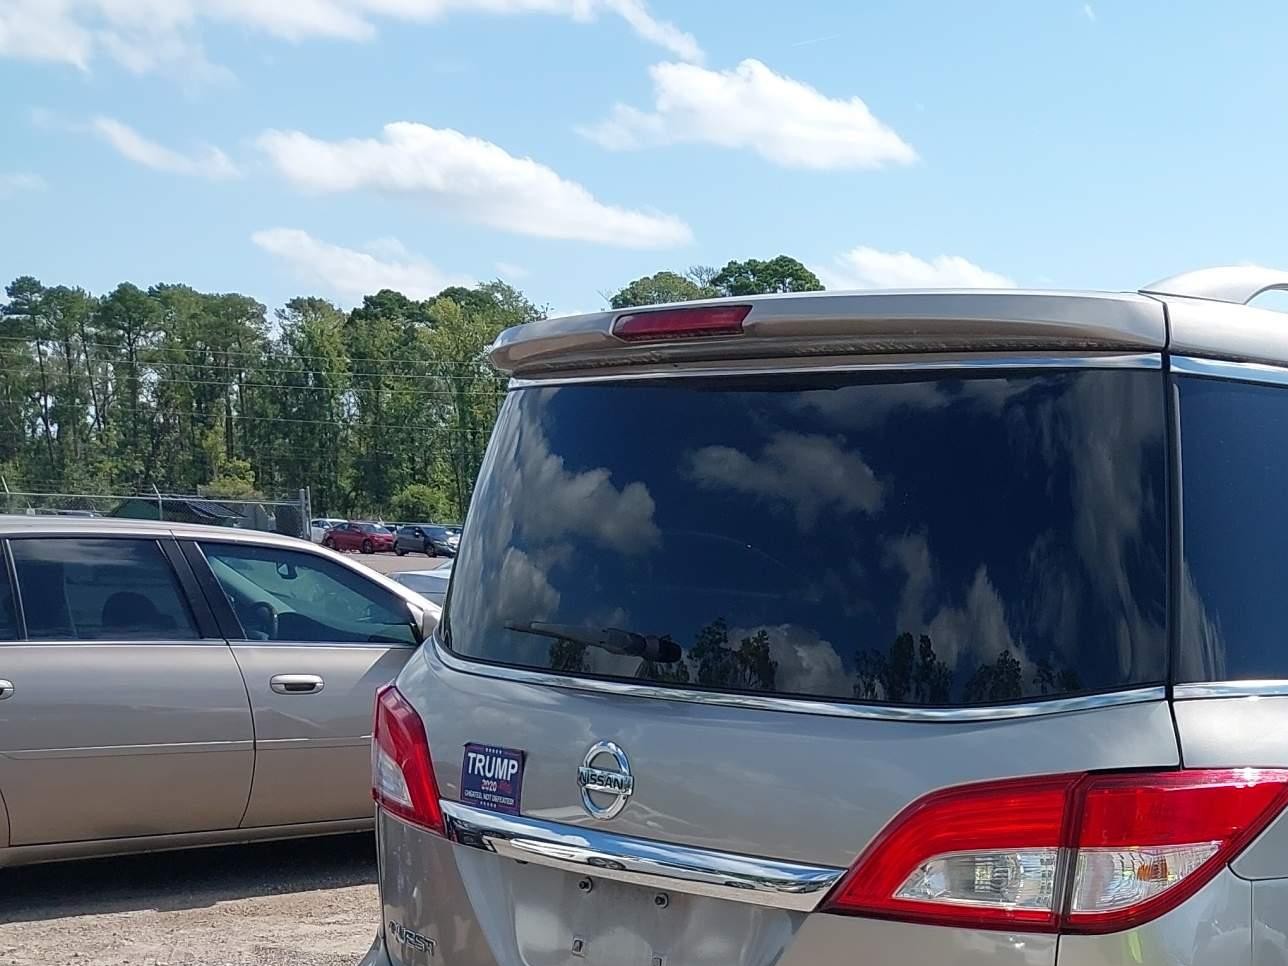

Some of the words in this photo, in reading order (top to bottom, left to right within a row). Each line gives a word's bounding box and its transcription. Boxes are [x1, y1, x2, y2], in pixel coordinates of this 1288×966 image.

[467, 752, 518, 780] TRUMP
[481, 779, 497, 792] 2020
[579, 770, 624, 790] NISSAN
